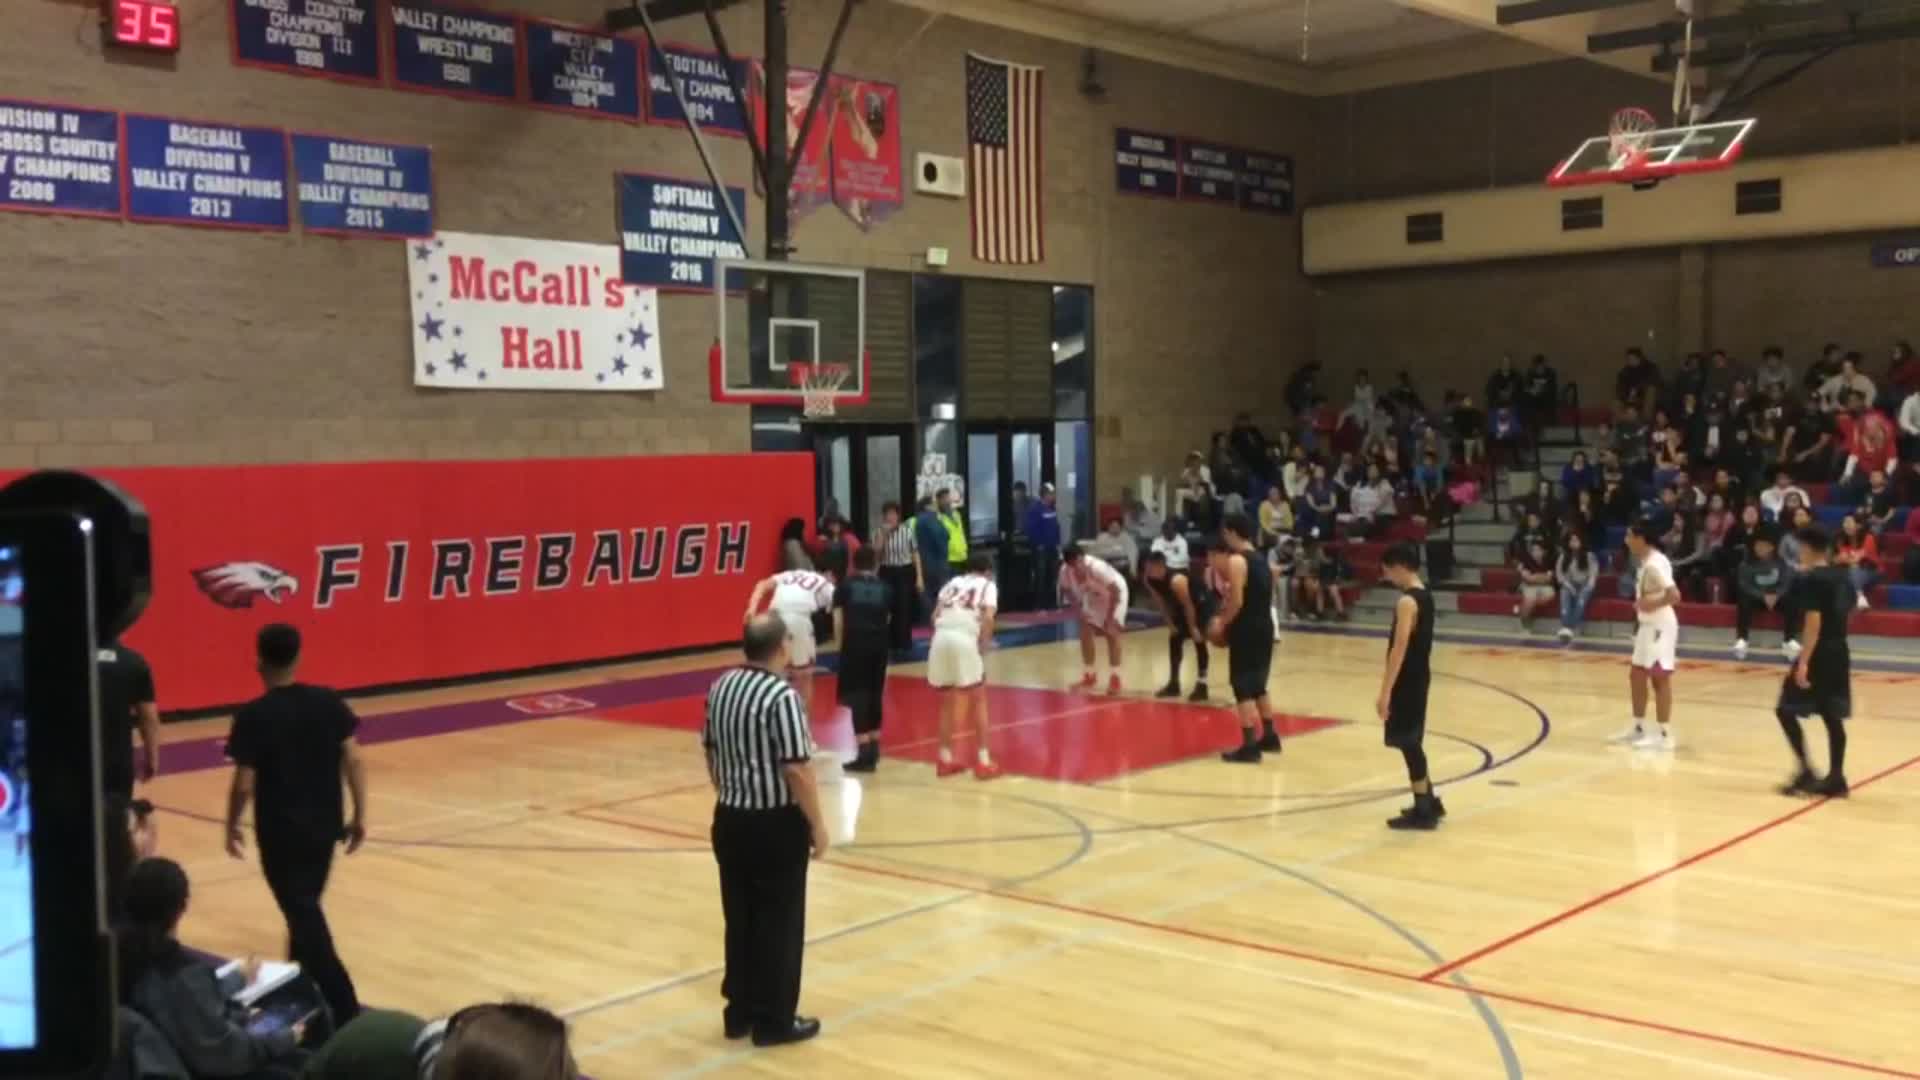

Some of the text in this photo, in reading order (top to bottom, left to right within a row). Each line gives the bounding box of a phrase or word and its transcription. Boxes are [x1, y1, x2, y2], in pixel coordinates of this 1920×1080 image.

[116, 2, 173, 46] 35
[305, 0, 365, 24] COUNTRY
[392, 6, 515, 44] VALLEY CHAMPIONS
[265, 27, 321, 49] DIVISION
[417, 34, 493, 64] WRESTLING
[61, 112, 79, 134] IV
[169, 123, 246, 150] BASEBALL
[0, 130, 117, 160] ROSS COUNTRY
[328, 141, 396, 167] BASEBALL
[14, 156, 112, 184] CHAMPIONS
[165, 146, 250, 174] DIVISION V
[323, 162, 385, 186] DIVISION
[132, 167, 283, 199] VALLEY CHAMPIONS
[298, 182, 430, 211] VALLEY CHAMPIONS
[652, 183, 715, 210] SOFTBALL
[190, 196, 232, 218] 2013
[346, 206, 384, 229] 2015
[649, 208, 720, 236] DIVISION V
[623, 231, 668, 255] VALLEY
[449, 254, 626, 308] McCall's
[669, 260, 703, 283] 2016
[500, 325, 583, 371] Hall
[312, 521, 750, 609] FIREBAUGH
